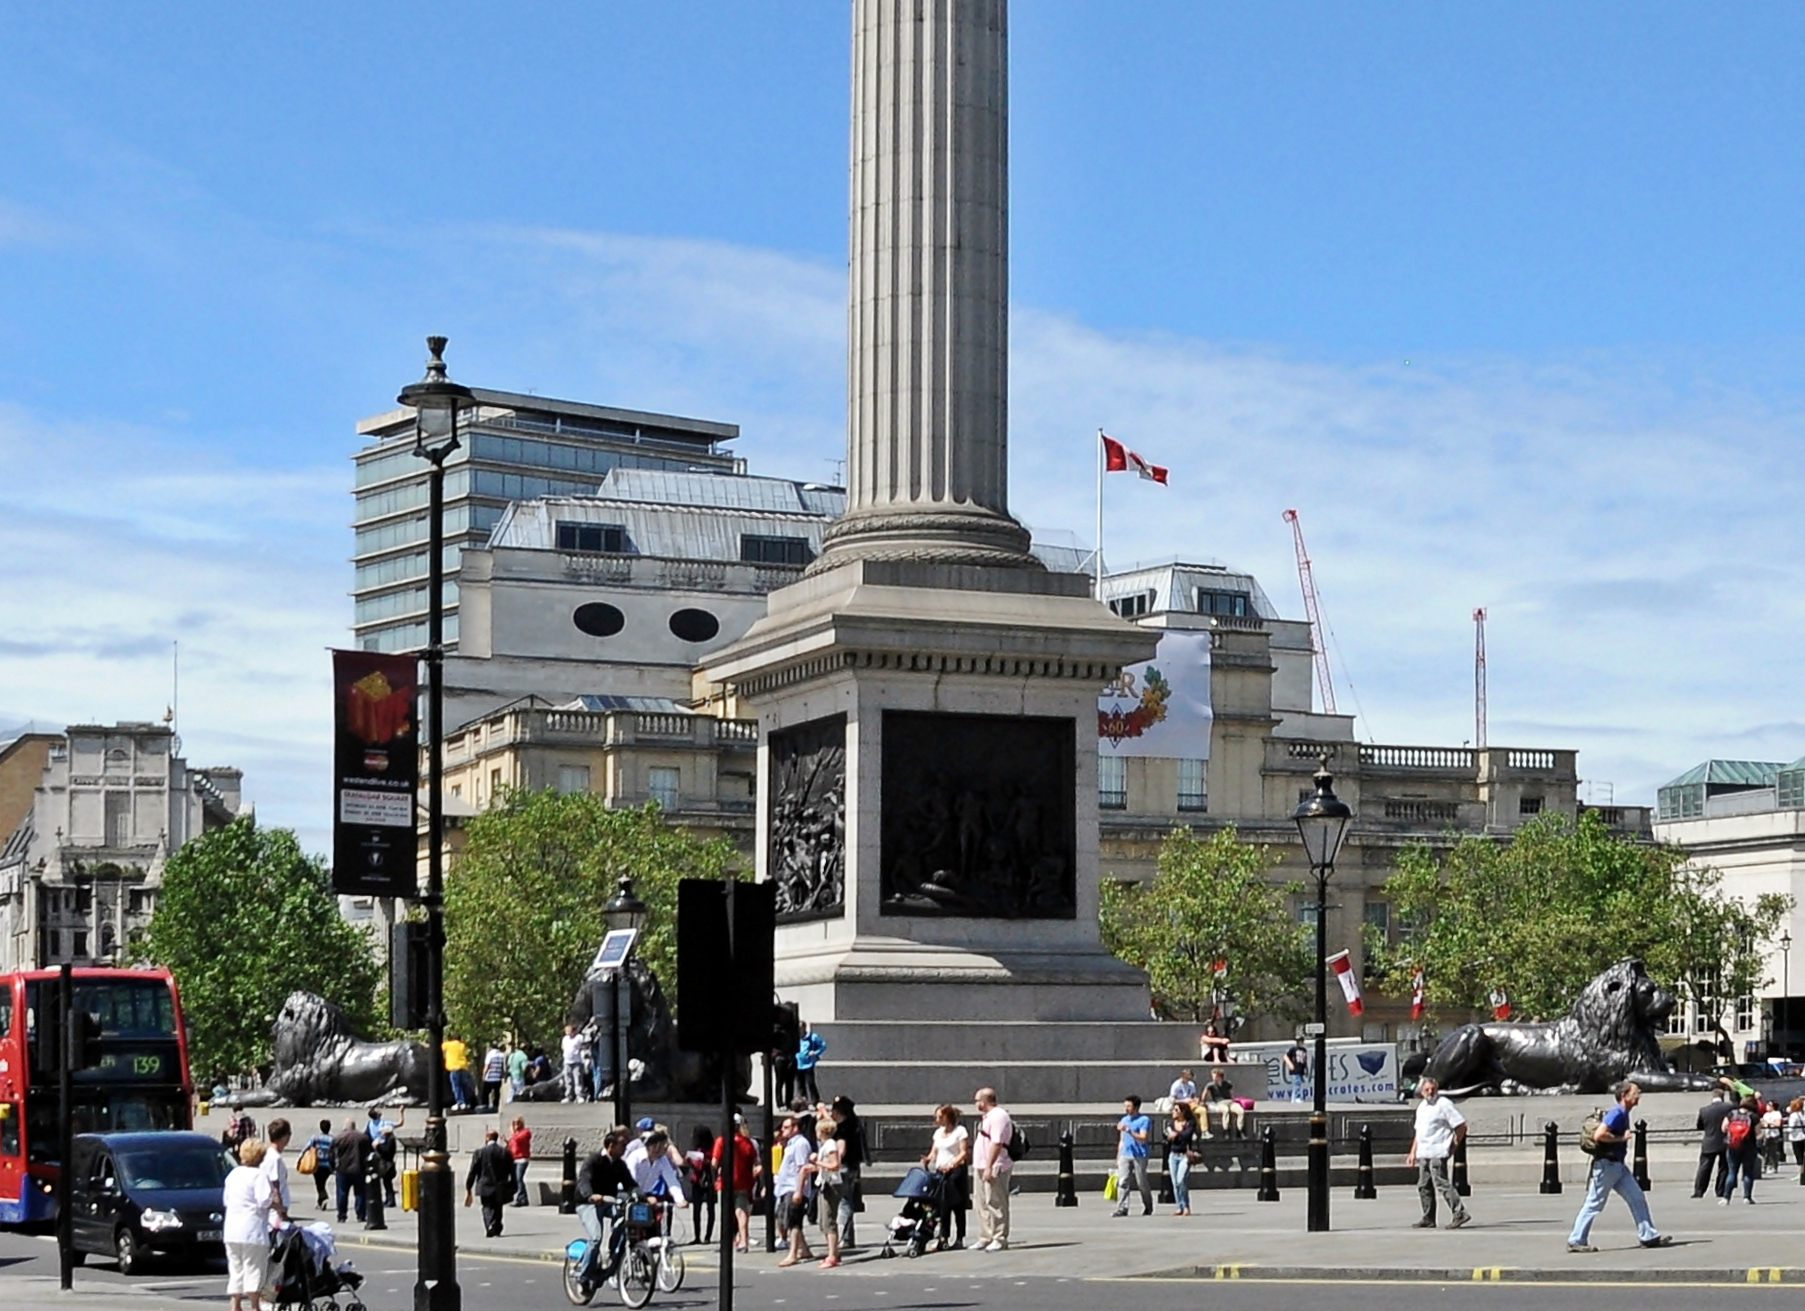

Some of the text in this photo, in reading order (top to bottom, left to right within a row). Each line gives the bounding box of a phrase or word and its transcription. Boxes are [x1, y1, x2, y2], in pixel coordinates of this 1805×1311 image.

[1108, 721, 1124, 735] 60
[134, 1056, 160, 1074] 139
[1264, 1057, 1280, 1086] PLUS
